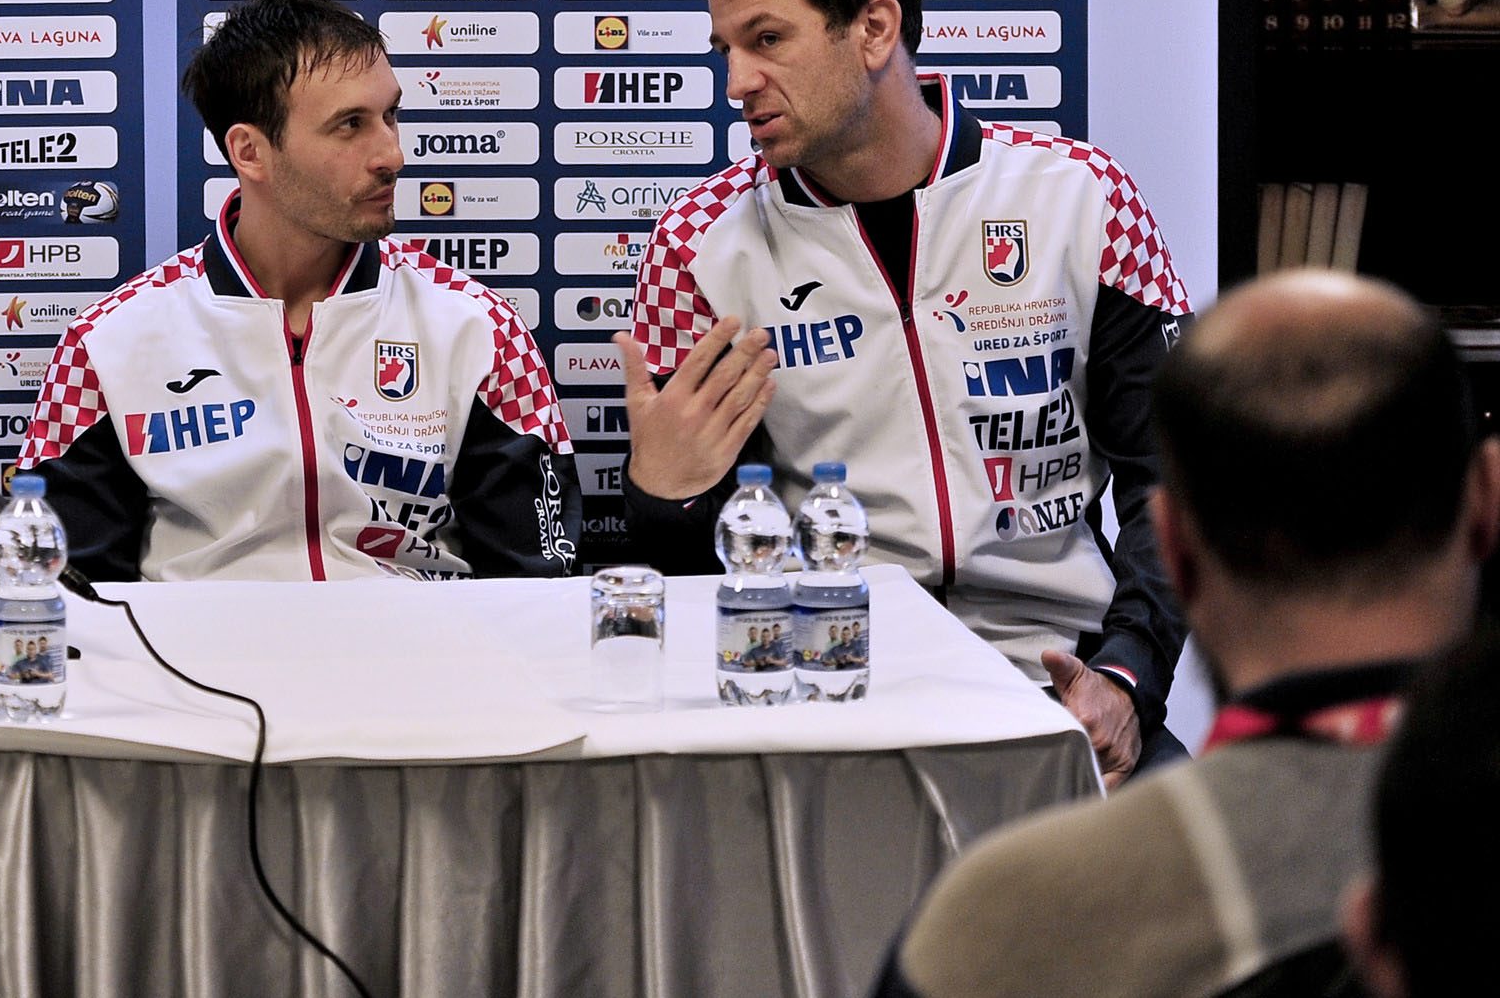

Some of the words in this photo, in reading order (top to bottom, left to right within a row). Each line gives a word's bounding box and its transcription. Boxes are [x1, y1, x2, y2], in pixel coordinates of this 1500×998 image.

[619, 74, 682, 102] HEP
[575, 132, 692, 145] PORSCHE
[986, 225, 1023, 237] HRS
[968, 303, 1021, 316] REPUBLIKA
[1024, 297, 1067, 311] HRVATSKA
[970, 317, 1024, 331] SREDIŠNJI
[1029, 311, 1067, 326] DRŽAVNI
[781, 315, 863, 368] HEP
[974, 337, 1010, 351] URED
[1013, 337, 1030, 348] ZA
[1033, 329, 1069, 346] ŠPORT
[380, 345, 414, 358] HRS
[170, 399, 256, 451] HEP
[969, 388, 1080, 451] TELE2
[416, 442, 446, 456] ŠPOR
[1018, 453, 1081, 493] HPB
